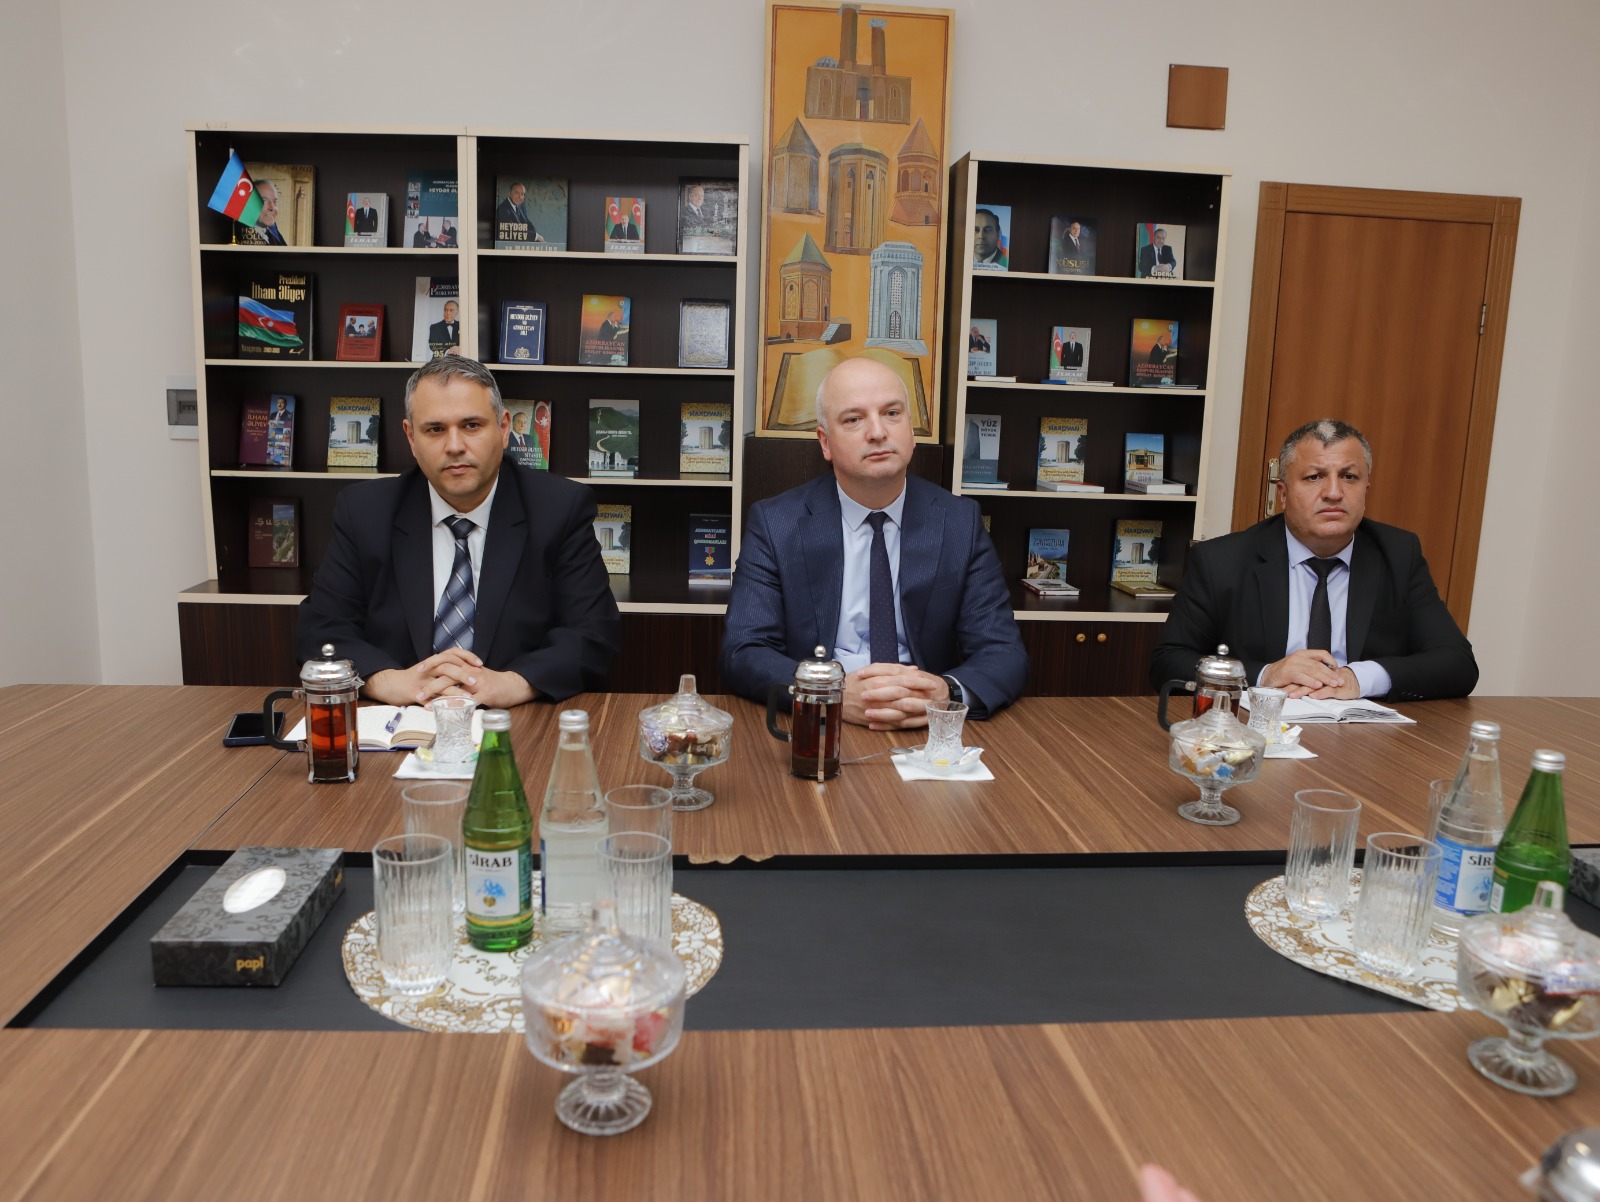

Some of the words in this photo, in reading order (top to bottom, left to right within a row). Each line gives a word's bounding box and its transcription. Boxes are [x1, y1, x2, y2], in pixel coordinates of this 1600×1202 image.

[499, 222, 528, 231] HEYDƏR
[499, 231, 528, 240] ƏLİYEV
[279, 275, 306, 285] Prezident
[251, 281, 276, 300] İlham
[278, 285, 306, 303] Əliyev
[981, 418, 997, 427] YÜZ
[1468, 854, 1492, 866] SİR
[236, 956, 264, 971] papi
